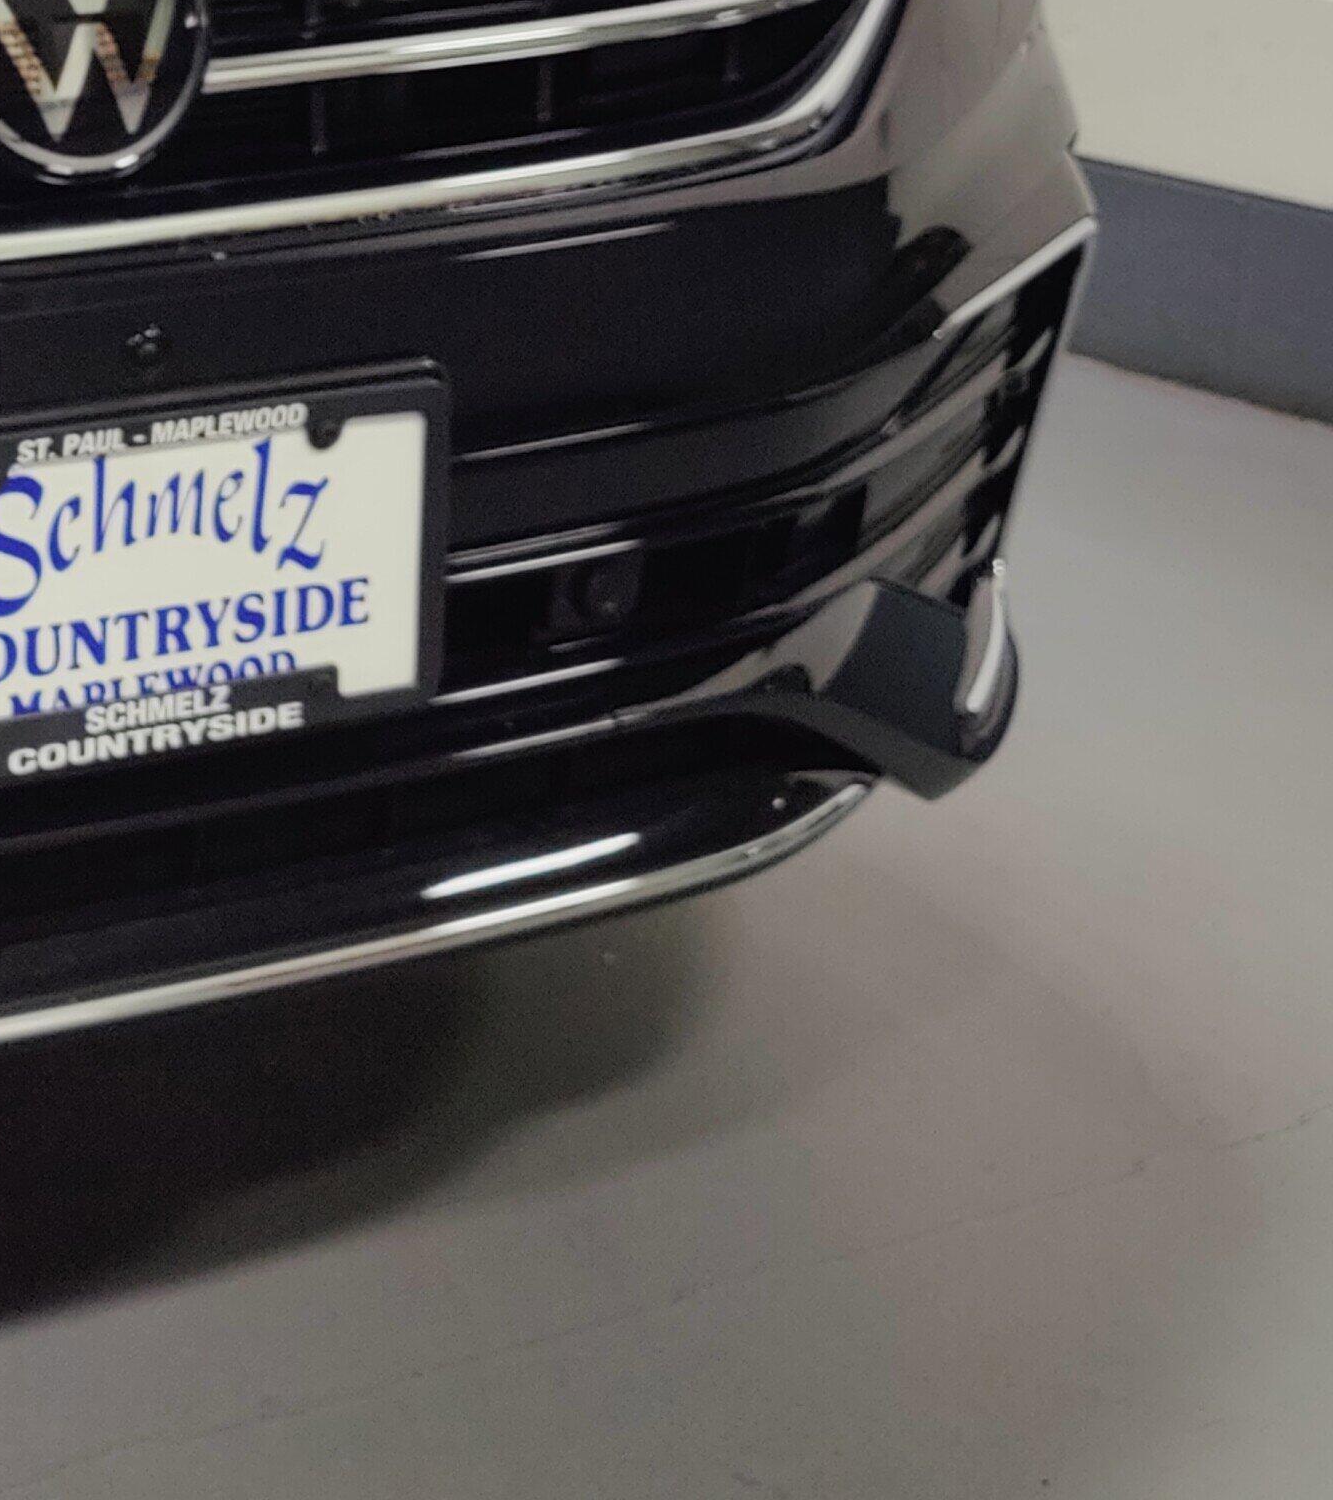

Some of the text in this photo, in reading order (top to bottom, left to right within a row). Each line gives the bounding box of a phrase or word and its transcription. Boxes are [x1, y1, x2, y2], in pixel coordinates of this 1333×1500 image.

[16, 437, 57, 463] ST.
[62, 427, 127, 457] PAUL
[150, 402, 308, 444] MAPLEWOOD
[7, 701, 305, 776] COUNTRYSIDE
[84, 685, 231, 734] SCHMELZ
